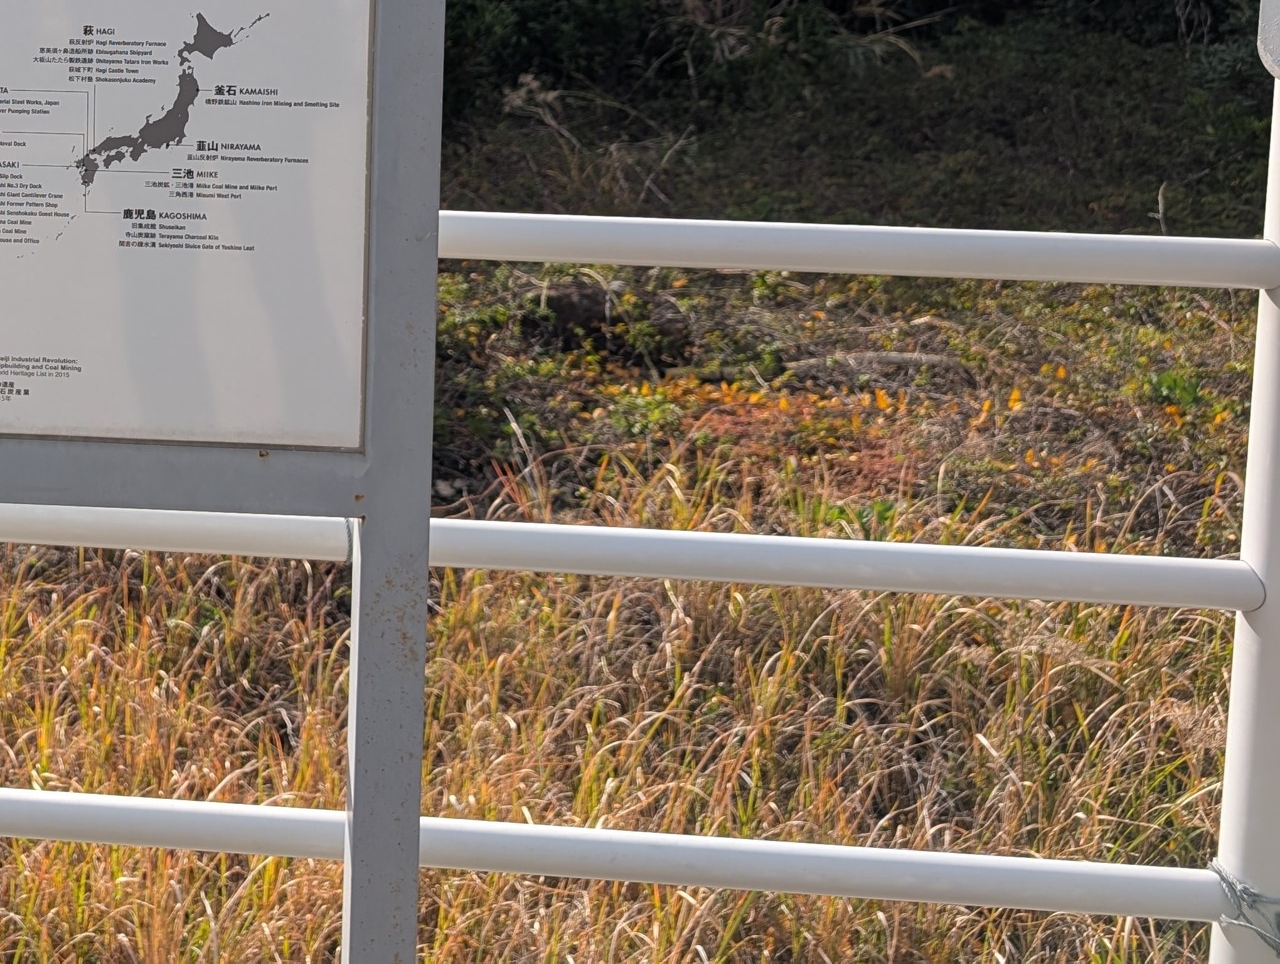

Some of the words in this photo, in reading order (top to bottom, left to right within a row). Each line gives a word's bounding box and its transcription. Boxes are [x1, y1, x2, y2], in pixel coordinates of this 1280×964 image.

[83, 25, 94, 36] 萩
[214, 85, 237, 96] 釜石
[196, 141, 218, 151] 韮山
[221, 143, 261, 151] NIRAYAMA
[172, 169, 194, 179] 三池
[123, 209, 156, 220] 鹿児島
[159, 212, 207, 220] KAGOSHIMA
[61, 364, 82, 372] Mining
